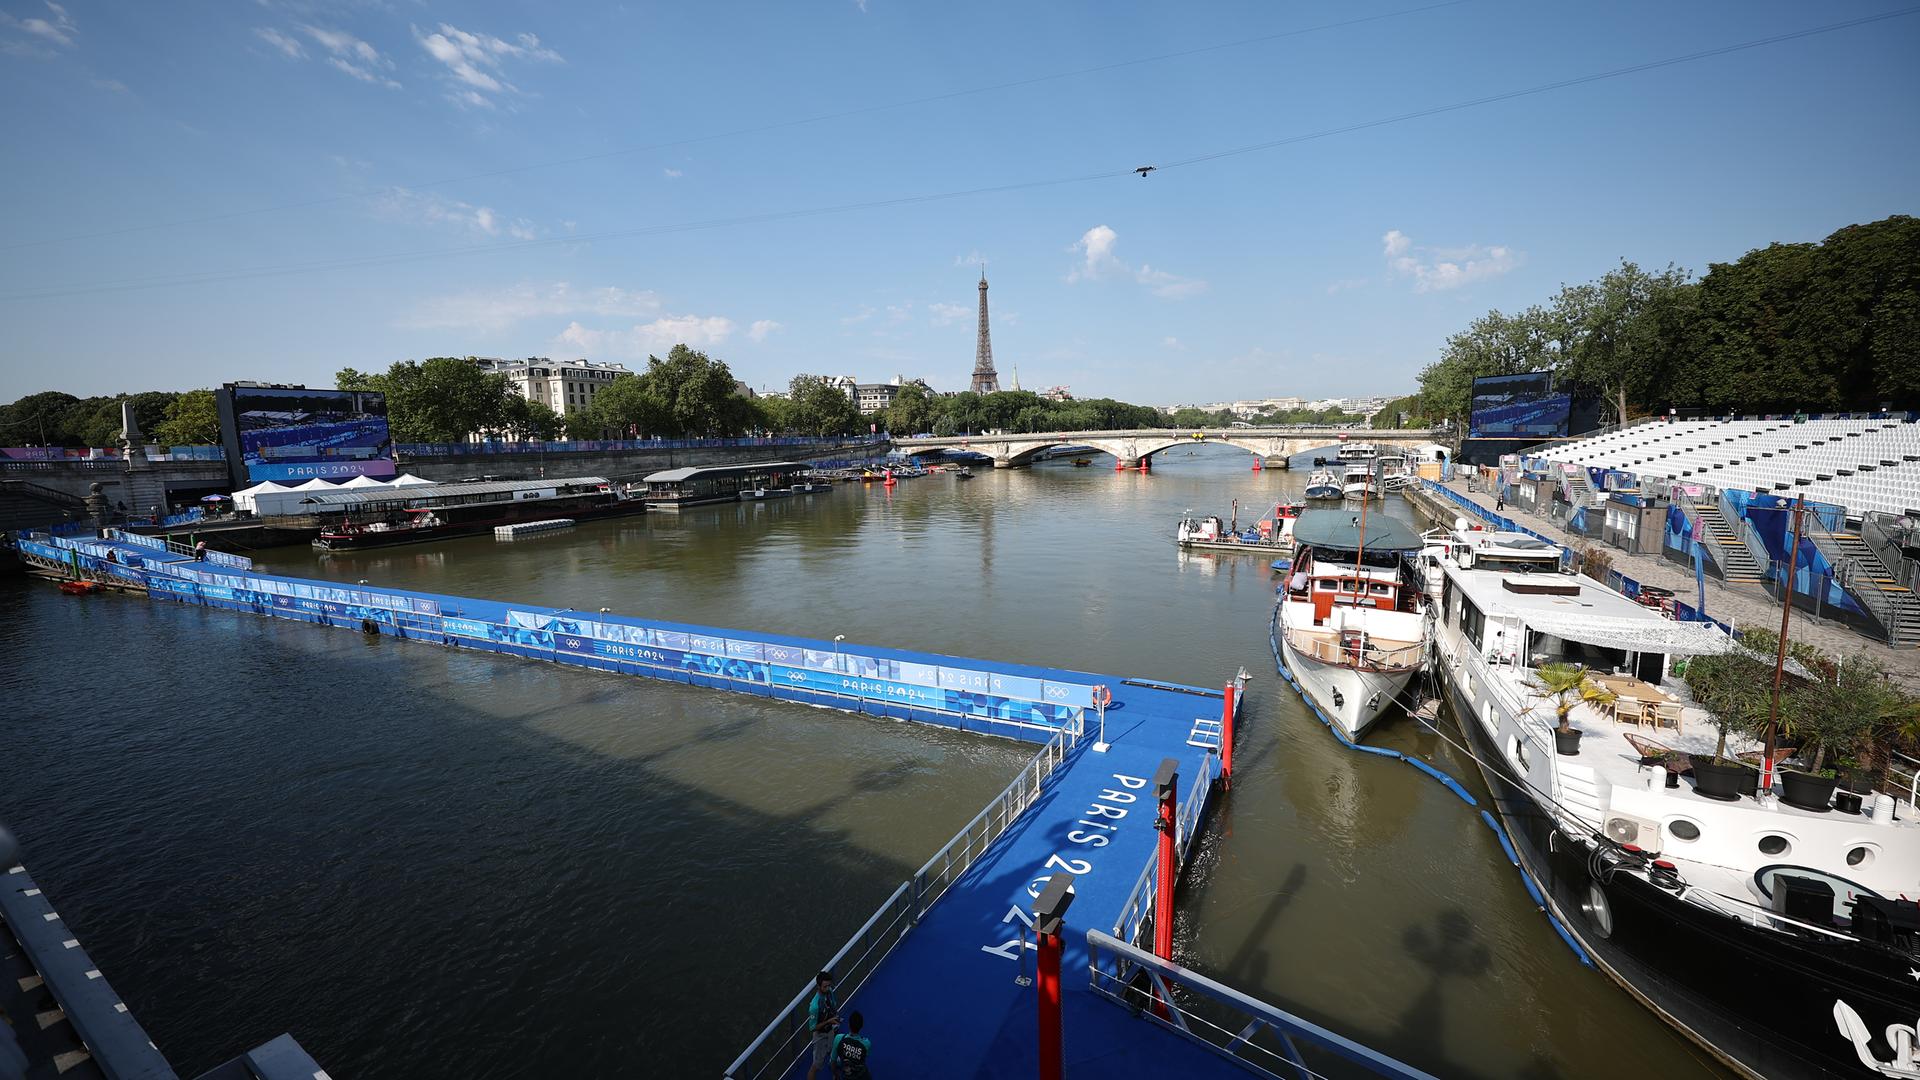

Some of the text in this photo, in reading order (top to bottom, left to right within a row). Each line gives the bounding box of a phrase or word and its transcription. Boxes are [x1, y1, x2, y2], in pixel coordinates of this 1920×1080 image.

[287, 464, 365, 476] PARIS 2024
[606, 644, 665, 662] PARIS 2024
[842, 679, 926, 701] PARIS 2024
[1067, 773, 1148, 848] PARIS
